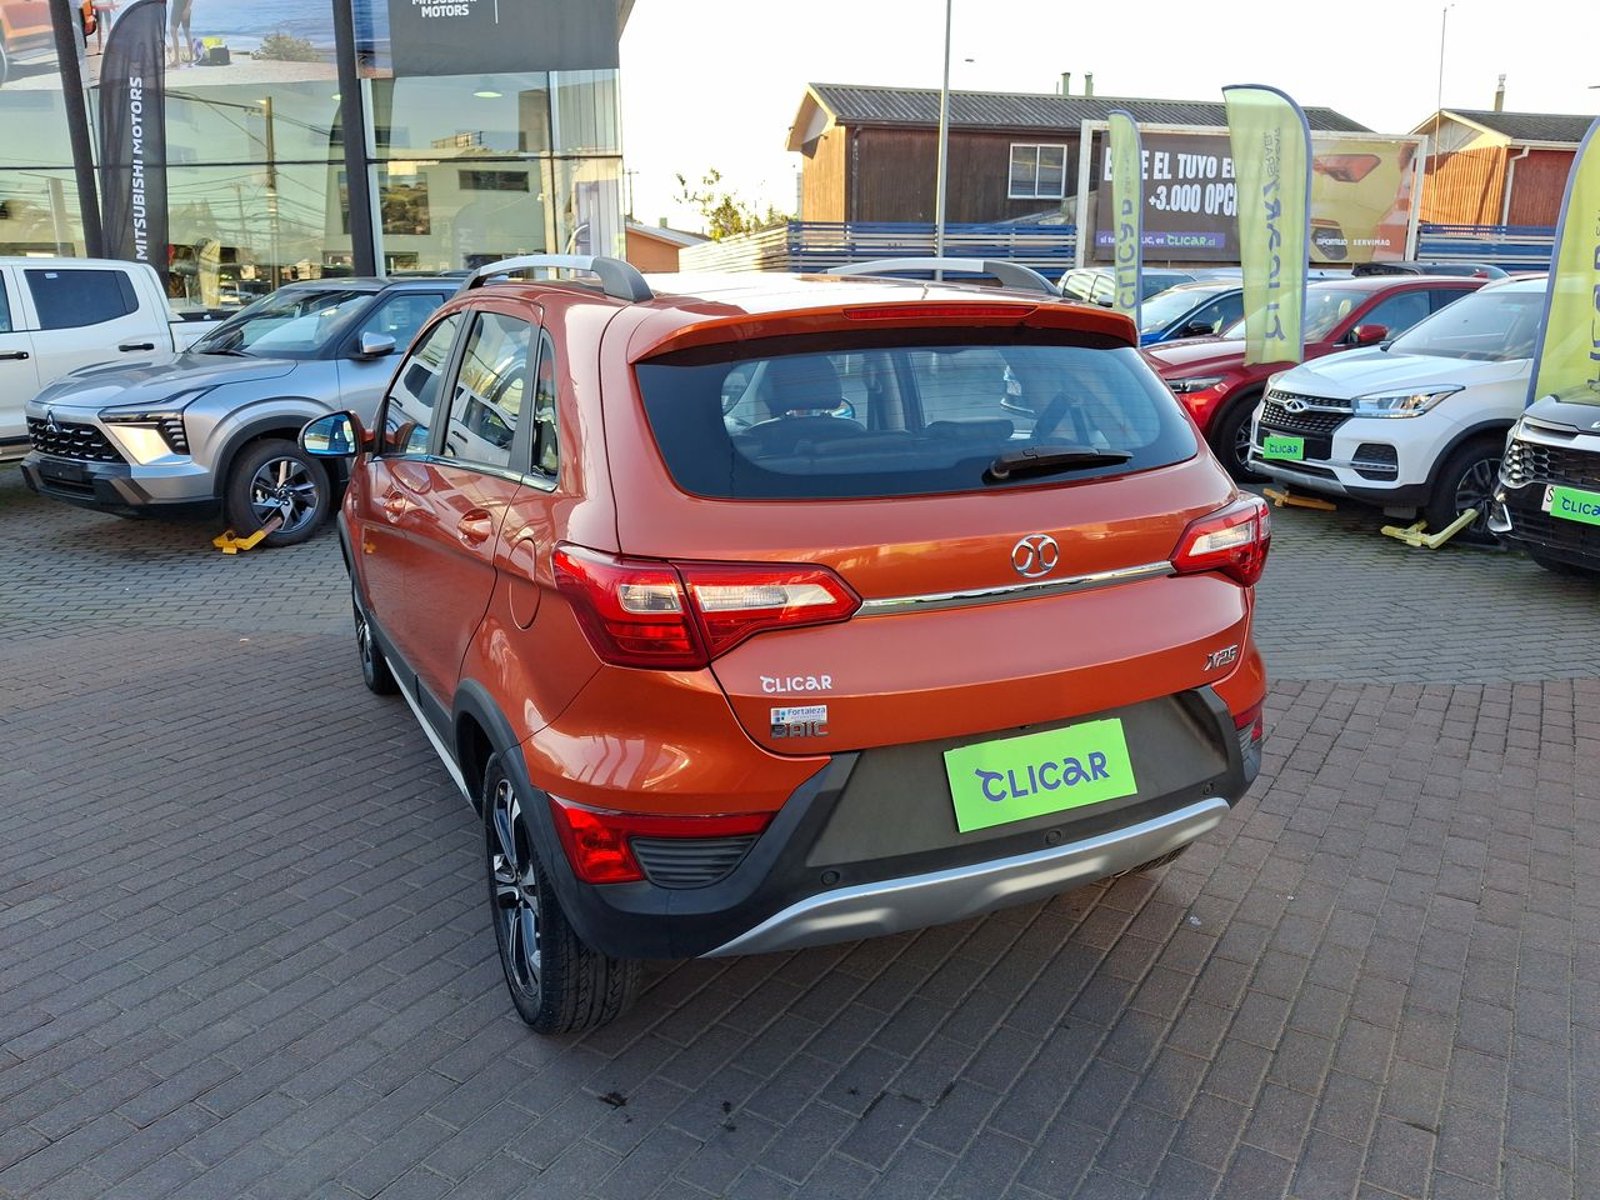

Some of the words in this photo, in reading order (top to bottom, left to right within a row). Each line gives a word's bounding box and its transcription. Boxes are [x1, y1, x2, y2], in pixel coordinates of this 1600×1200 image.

[421, 4, 469, 18] MOTORS
[130, 76, 143, 155] MOTORS
[1153, 151, 1172, 180] EL
[1177, 153, 1217, 179] TUYO
[133, 159, 148, 261] MITSUBISHI
[1148, 184, 1201, 213] +3.000
[787, 706, 826, 716] Fortaleza
[771, 721, 829, 738] BAIC
